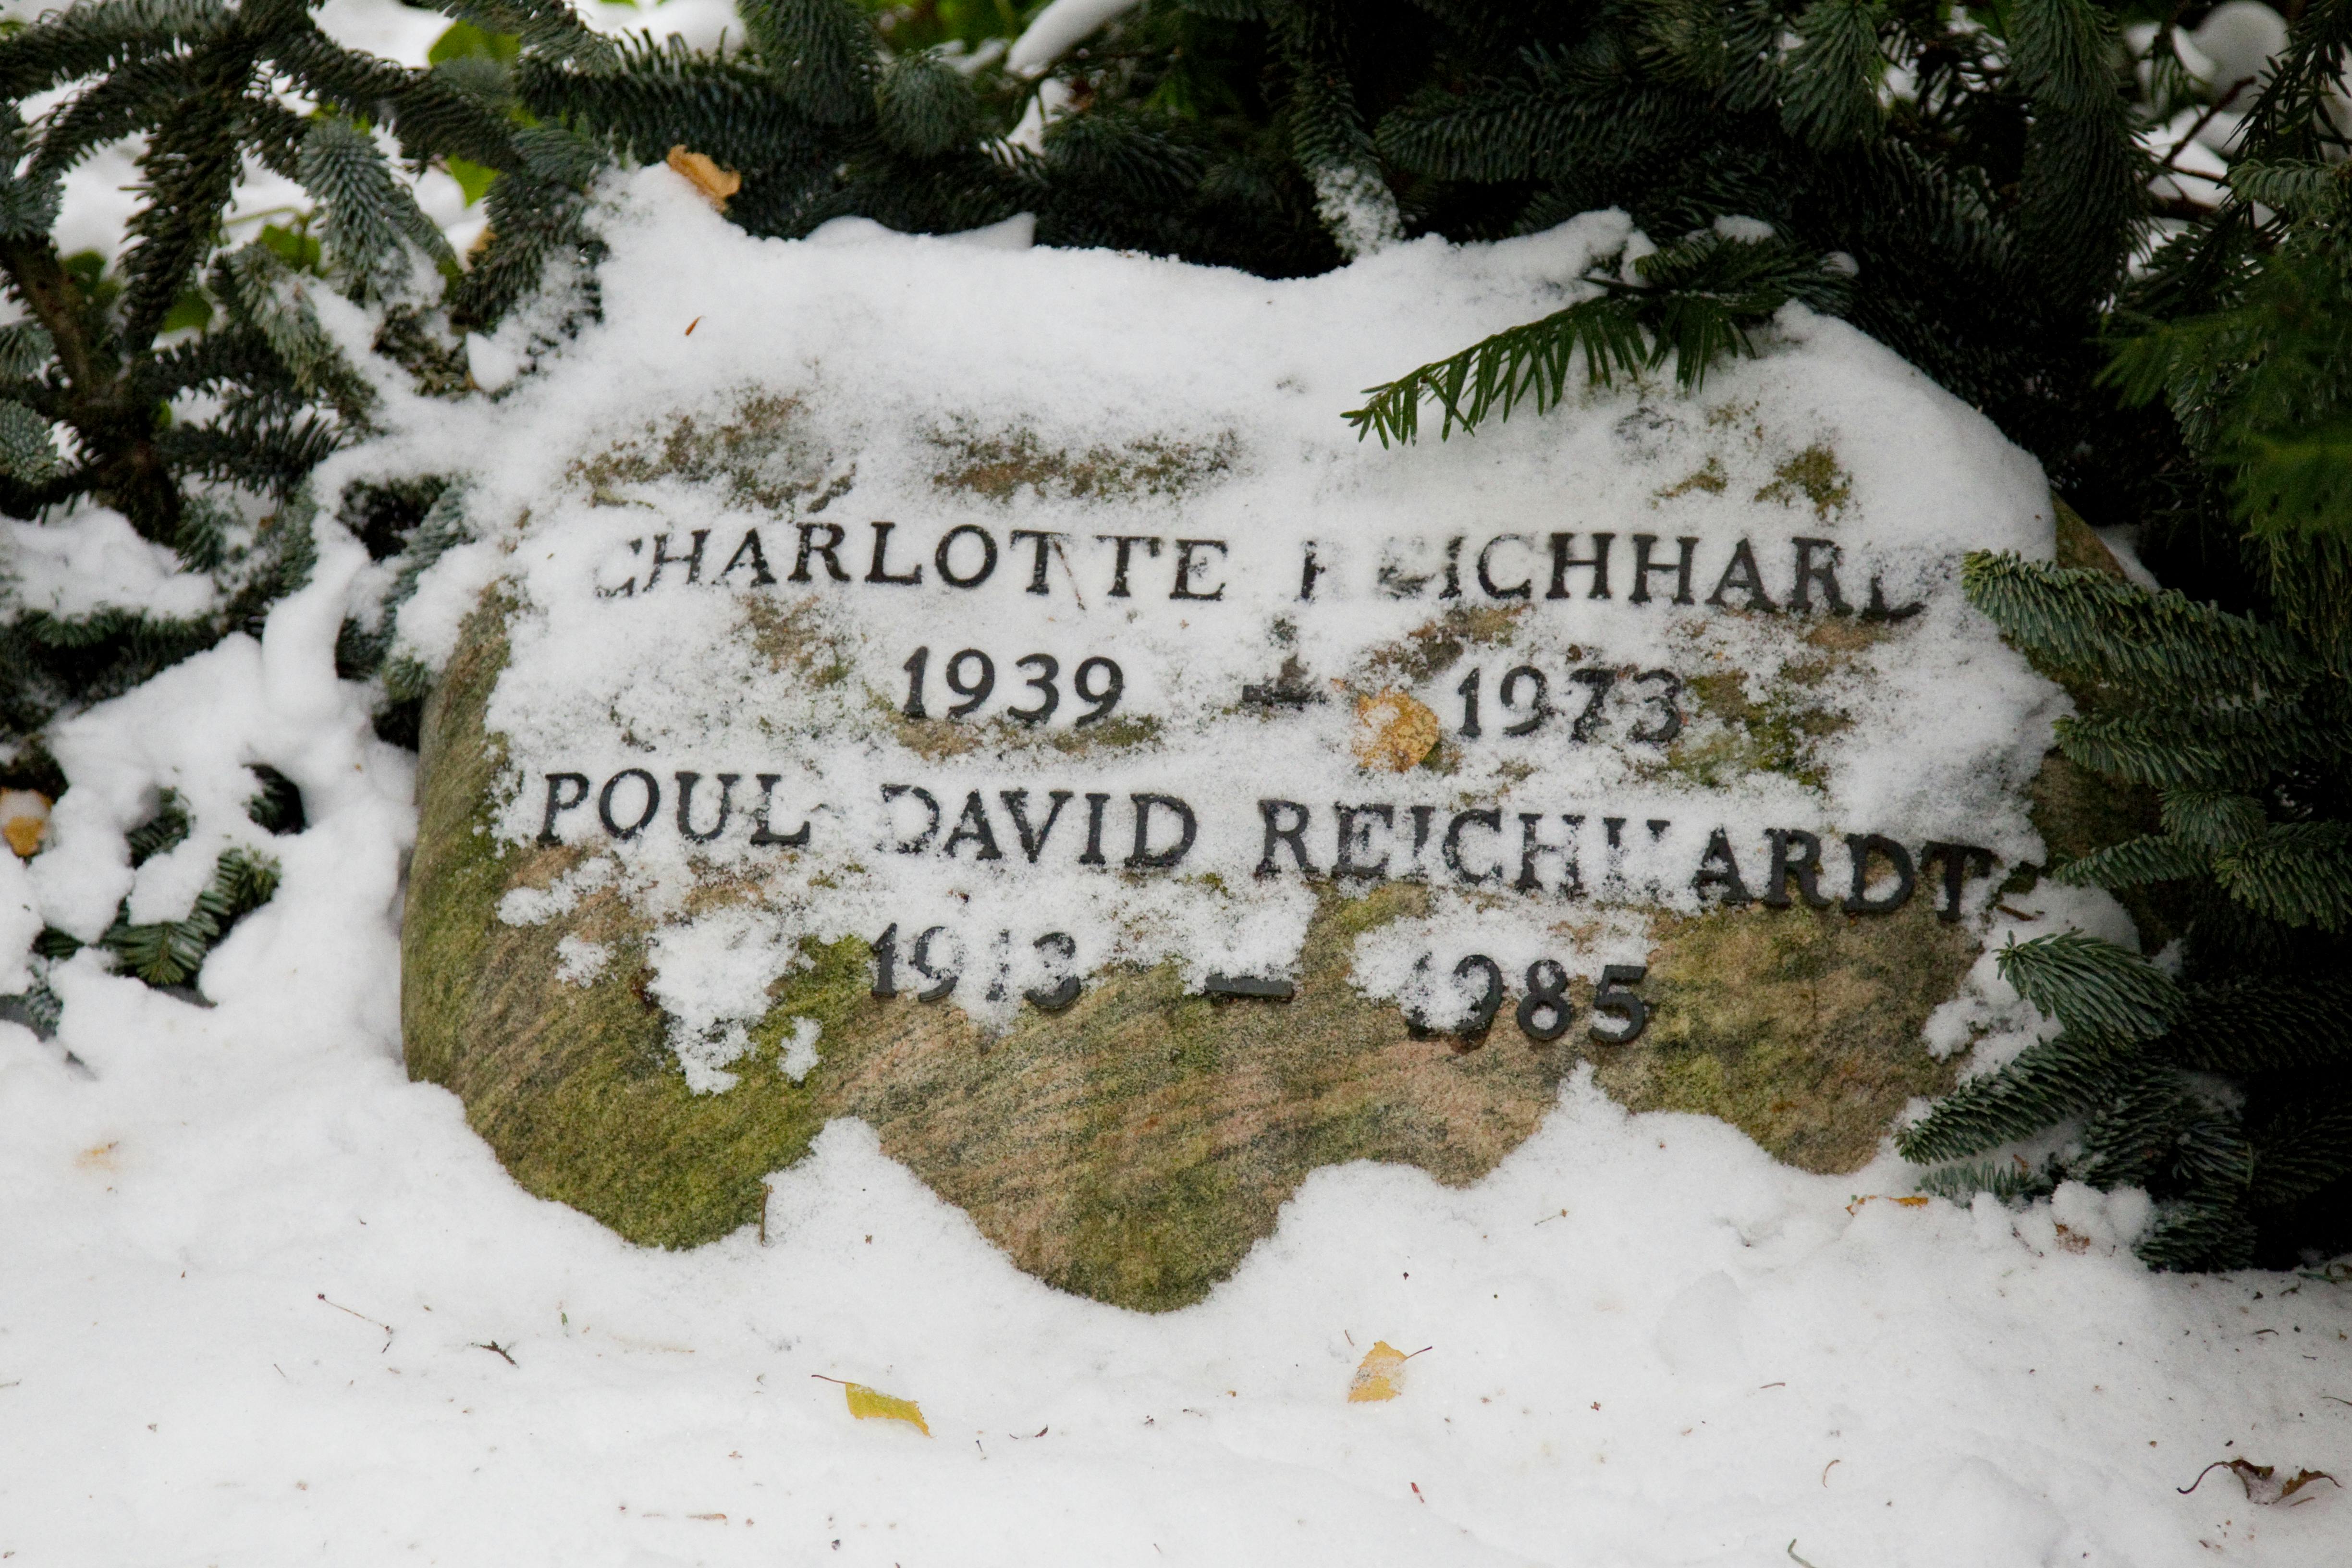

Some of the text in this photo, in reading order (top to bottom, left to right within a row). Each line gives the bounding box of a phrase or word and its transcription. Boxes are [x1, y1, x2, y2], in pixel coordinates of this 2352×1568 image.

[902, 645, 1124, 727] 1939
[1457, 666, 1681, 745] 1973
[536, 769, 811, 847] POUL
[879, 783, 1198, 867] DAVID
